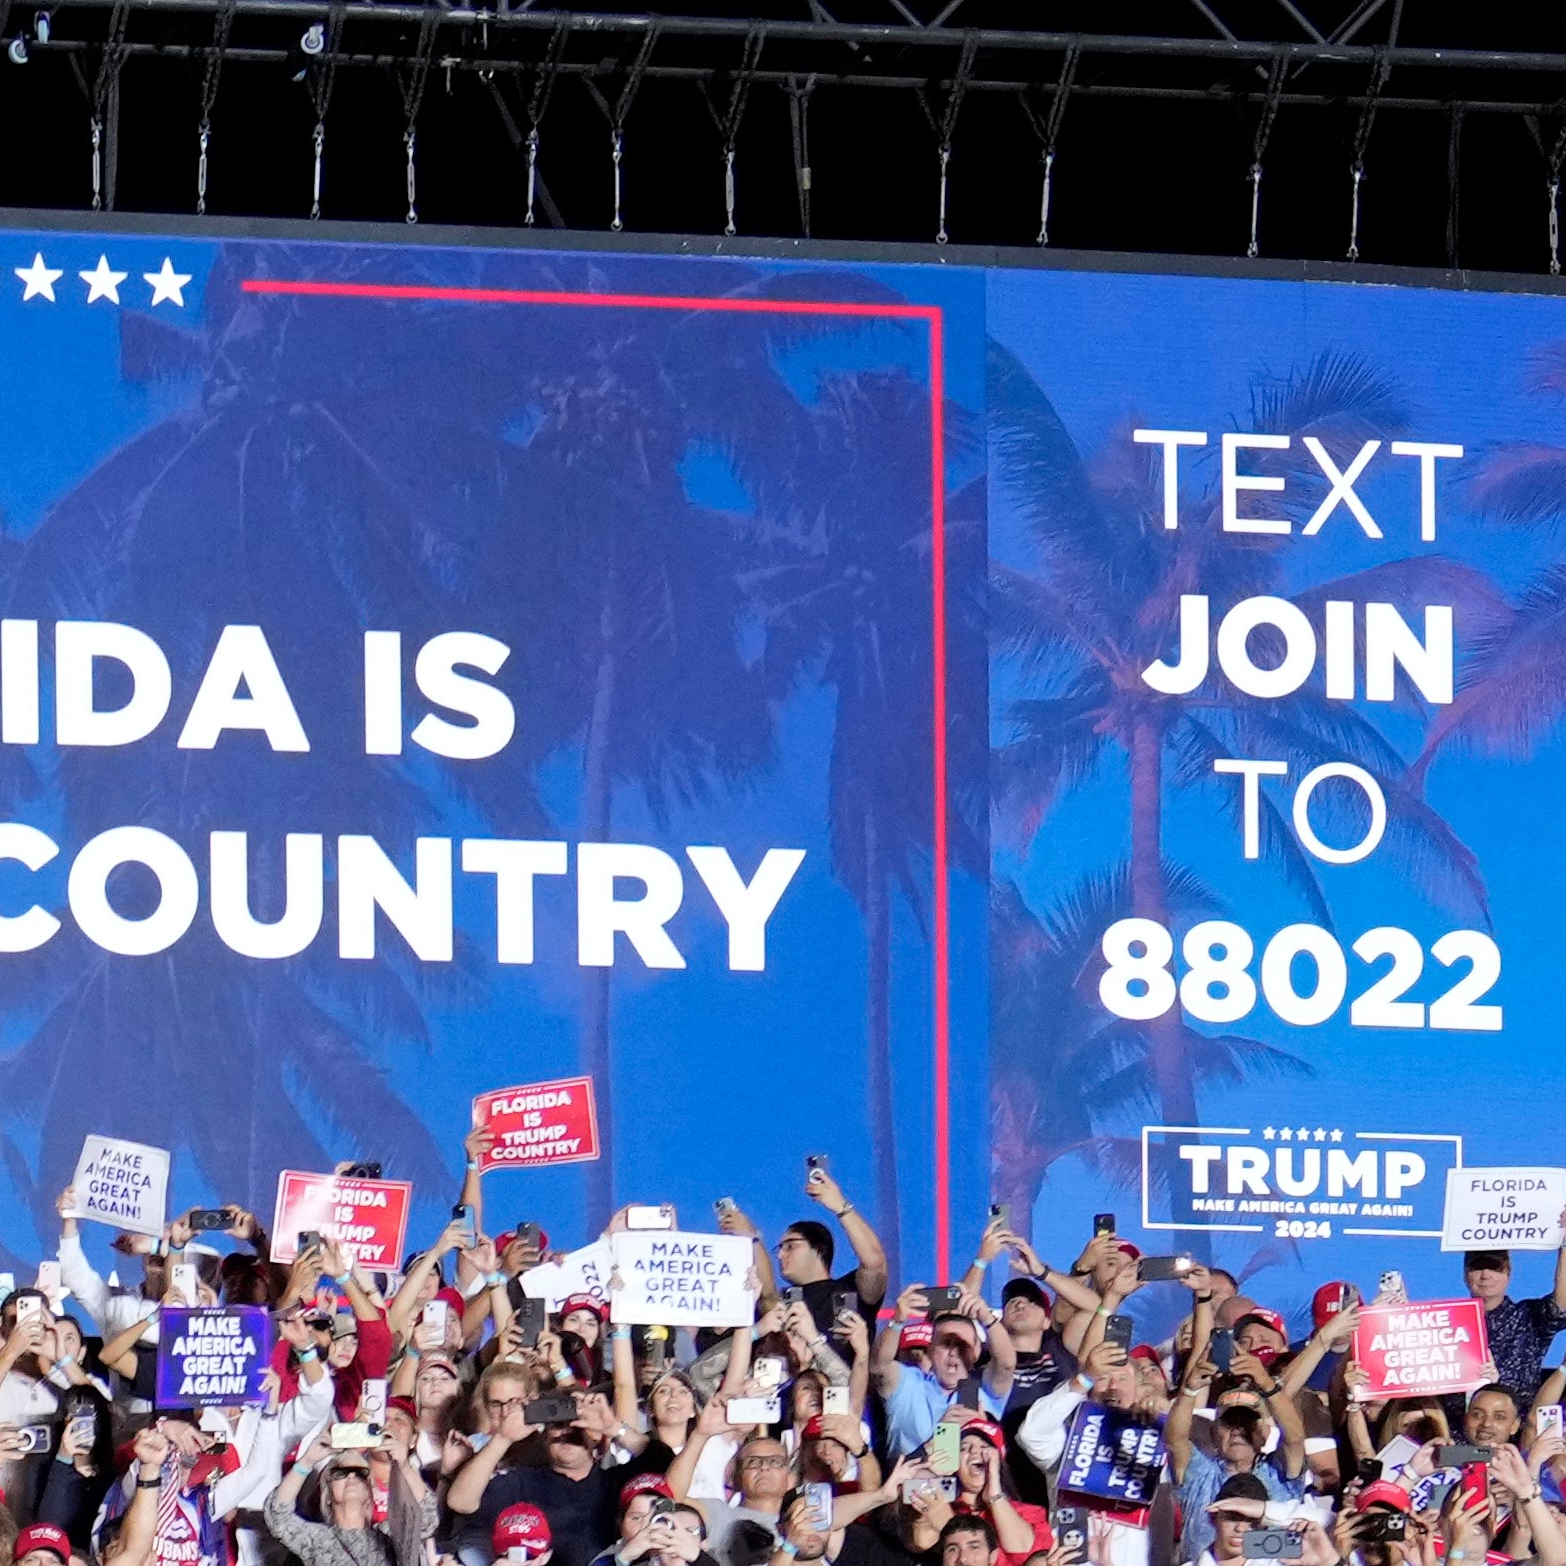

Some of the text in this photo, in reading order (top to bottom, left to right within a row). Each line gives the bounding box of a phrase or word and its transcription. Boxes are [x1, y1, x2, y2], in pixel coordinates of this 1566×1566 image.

[1133, 429, 1464, 541] TEXT
[1141, 594, 1453, 704] JOIN
[364, 631, 515, 760] IS
[1214, 759, 1386, 864] TO
[1099, 918, 1502, 1031] 88022
[490, 1090, 573, 1118] FLORIDA
[522, 1111, 544, 1129] IS
[500, 1124, 569, 1146] TRUMP
[99, 1147, 144, 1170] MAKE
[490, 1137, 582, 1162] COUNTRY
[84, 1162, 152, 1190] AMERICA
[1179, 1144, 1427, 1200] TRUMP
[88, 1179, 142, 1204] GREAT
[1469, 1179, 1548, 1193] FLORIDA
[87, 1196, 142, 1220] AGAIN!
[1192, 1199, 1414, 1218] MAKE AMERICA GREAT AGAIN!
[1500, 1196, 1517, 1208] IS
[334, 1206, 355, 1223] IS
[1476, 1212, 1539, 1226] TRUMP
[1275, 1220, 1332, 1239] 2024
[1461, 1226, 1550, 1242] COUNTRY
[651, 1242, 714, 1259] MAKE
[633, 1259, 733, 1278] AMERICA
[645, 1277, 721, 1295] GREAT
[188, 1316, 242, 1337] MAKE
[1387, 1310, 1451, 1332] MAKE
[171, 1336, 257, 1357] AMERICA
[1369, 1327, 1470, 1352] AMERICA
[182, 1356, 247, 1377] GREAT
[1383, 1345, 1459, 1369] GREAT
[178, 1375, 248, 1396] AGAIN!
[1382, 1362, 1462, 1387] AGAIN!
[1068, 1414, 1106, 1488] FLORIDA
[1095, 1444, 1115, 1464] IS
[1107, 1428, 1140, 1488] TRUMP
[1124, 1428, 1161, 1500] COUNTR
[153, 1538, 200, 1561] UBANS
